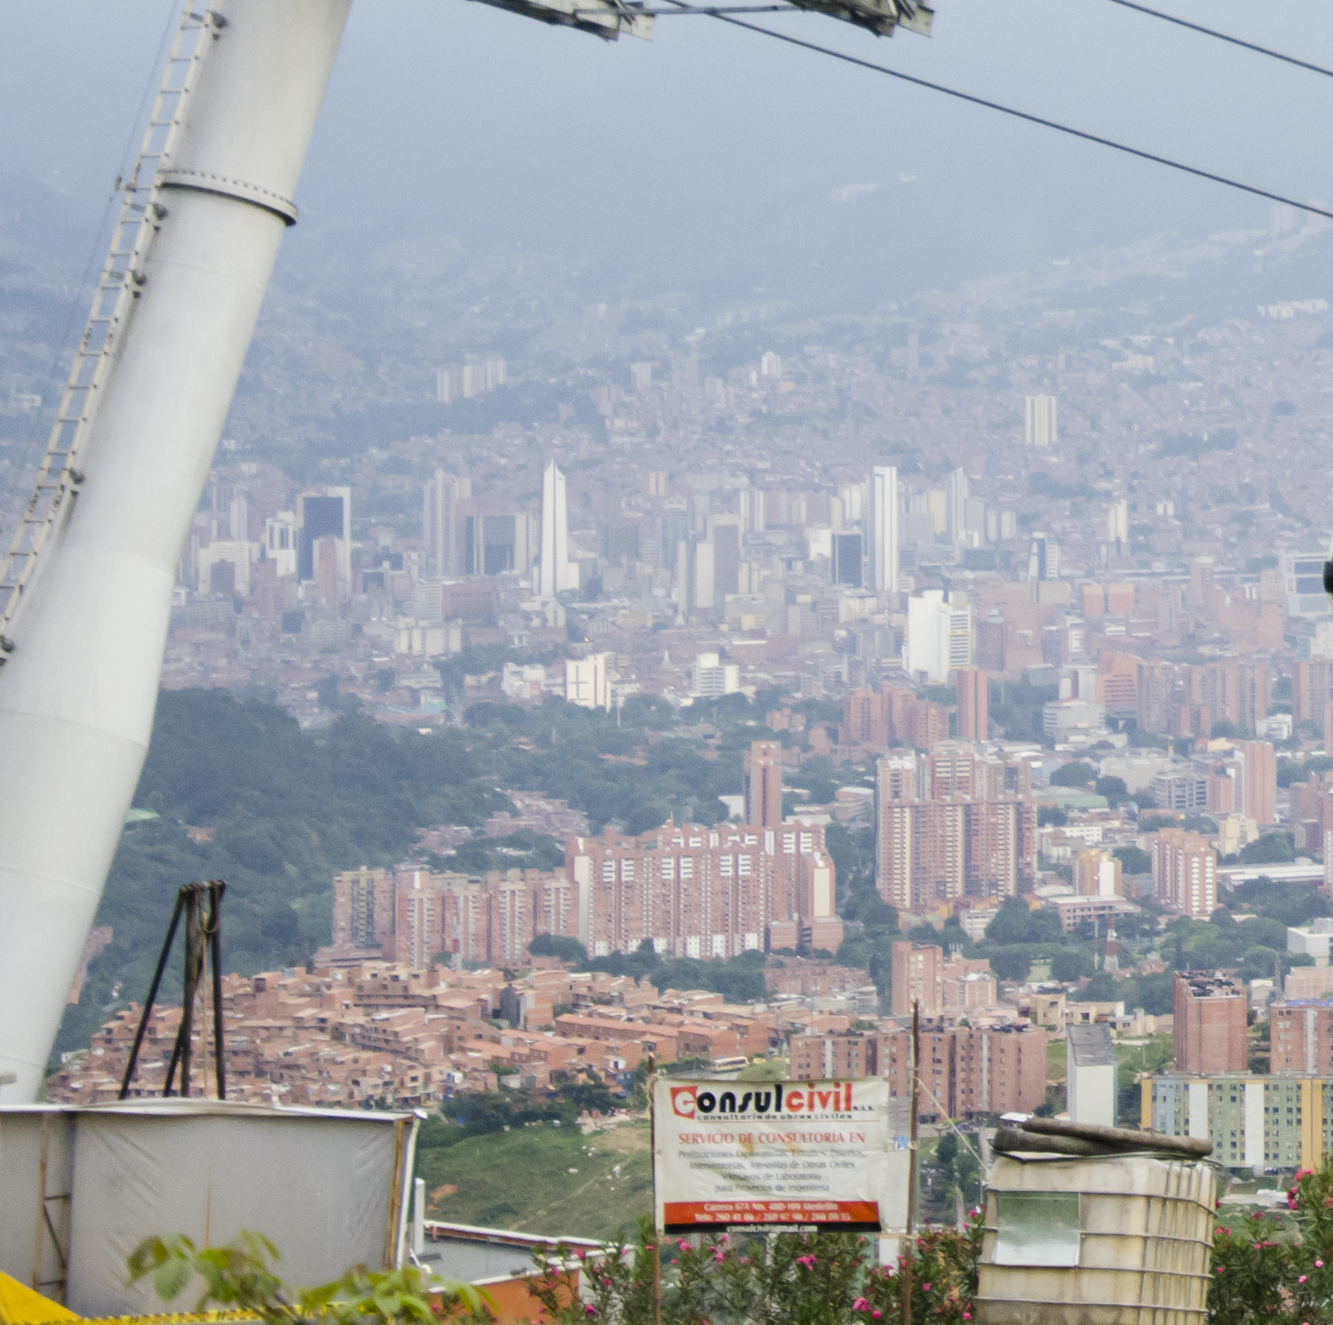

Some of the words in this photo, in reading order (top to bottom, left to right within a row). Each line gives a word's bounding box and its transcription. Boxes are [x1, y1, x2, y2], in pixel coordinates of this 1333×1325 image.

[678, 1133, 735, 1145] SERVICIO
[738, 1133, 754, 1145] DE
[849, 1132, 866, 1144] EN
[790, 1161, 799, 1169] de
[763, 1172, 773, 1180] de
[775, 1184, 785, 1192] de
[704, 1203, 733, 1211] Carrera
